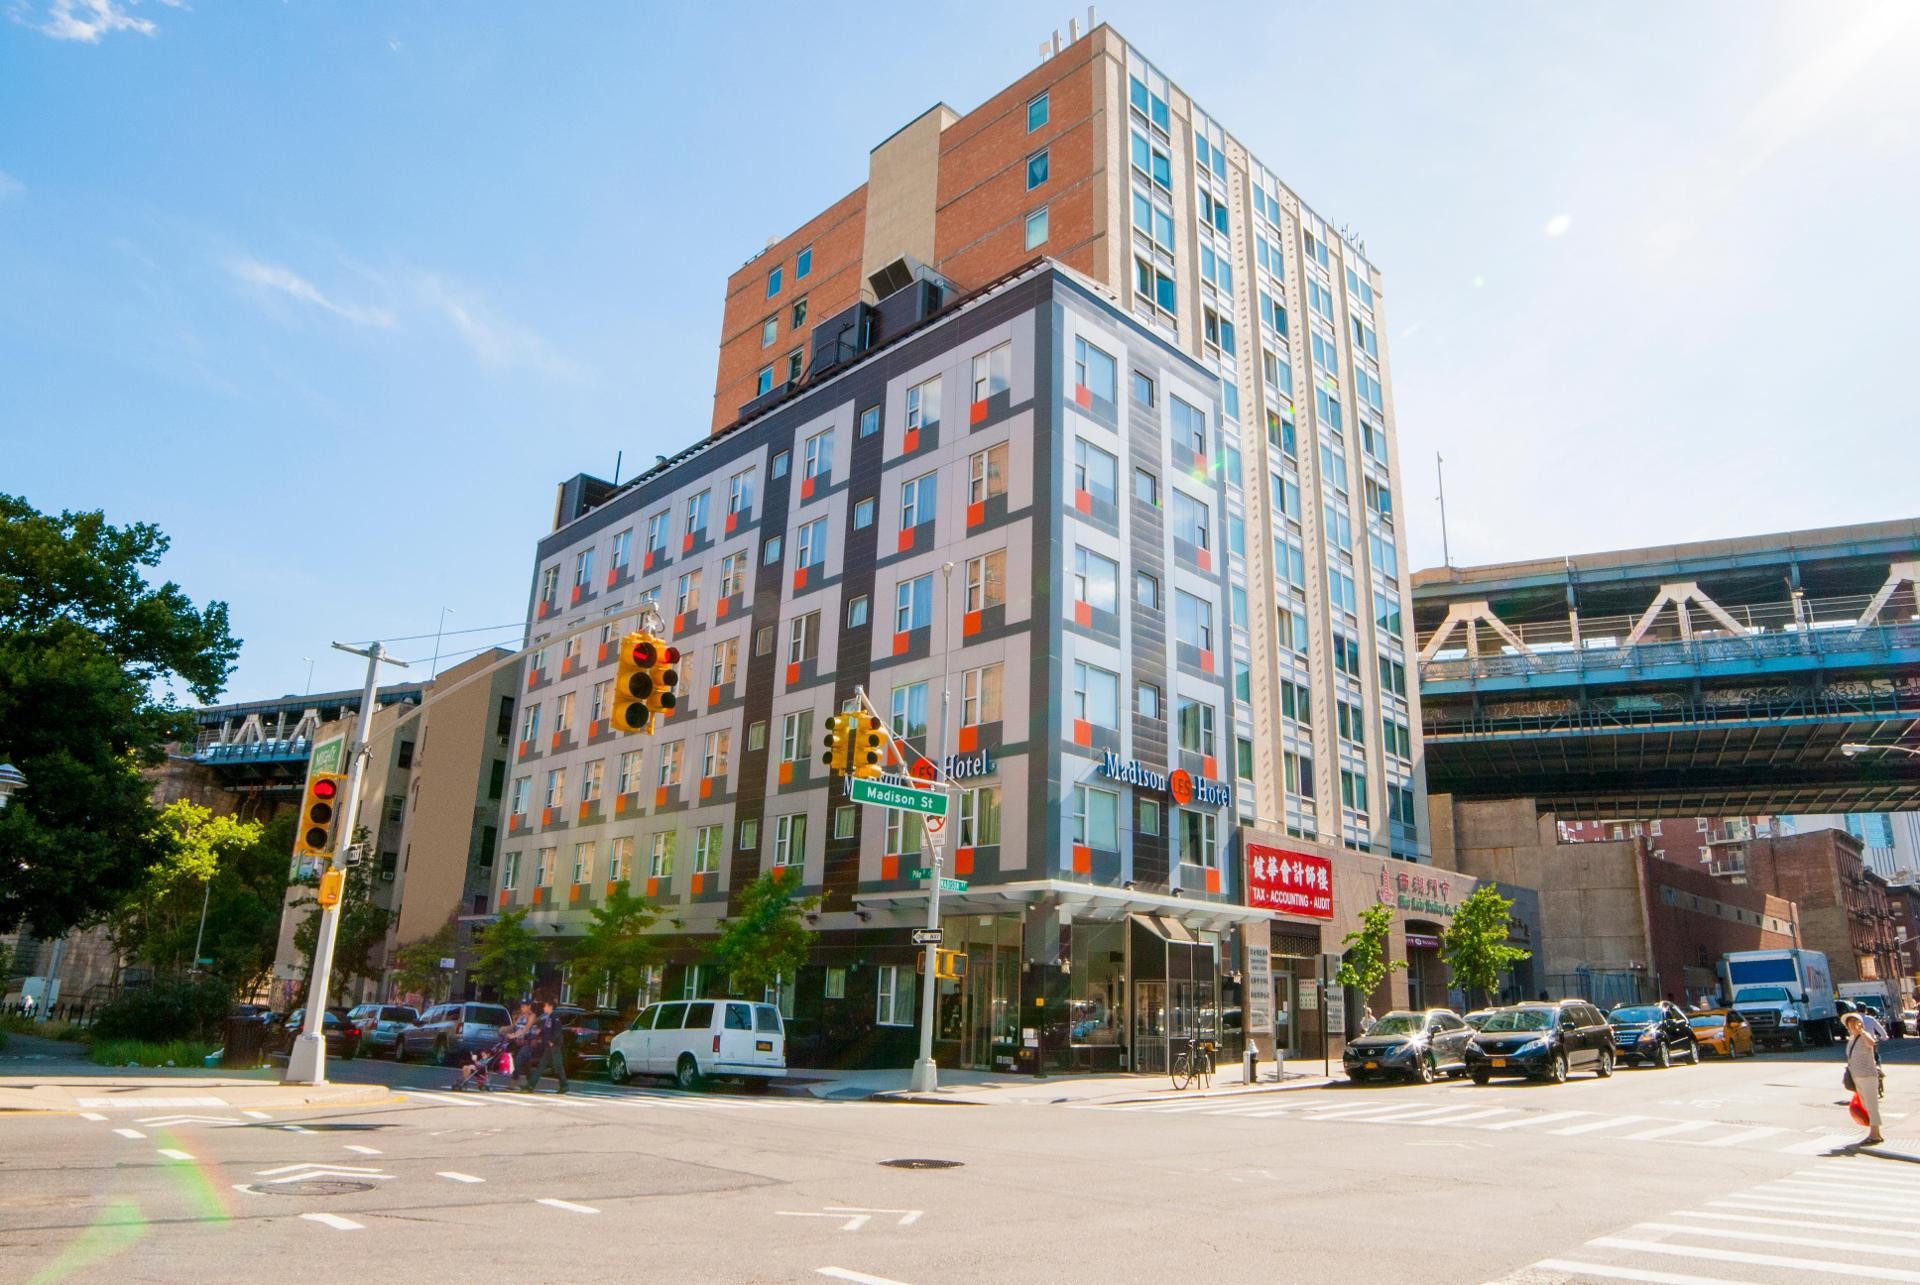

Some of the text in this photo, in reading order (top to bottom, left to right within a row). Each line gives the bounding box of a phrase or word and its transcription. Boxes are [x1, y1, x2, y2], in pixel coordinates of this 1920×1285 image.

[944, 748, 988, 781] Hotel
[1106, 750, 1233, 808] Madison LES Hotel
[867, 786, 934, 809] Madison St
[1252, 887, 1331, 911] TAX ACCOUNTING AUDIT
